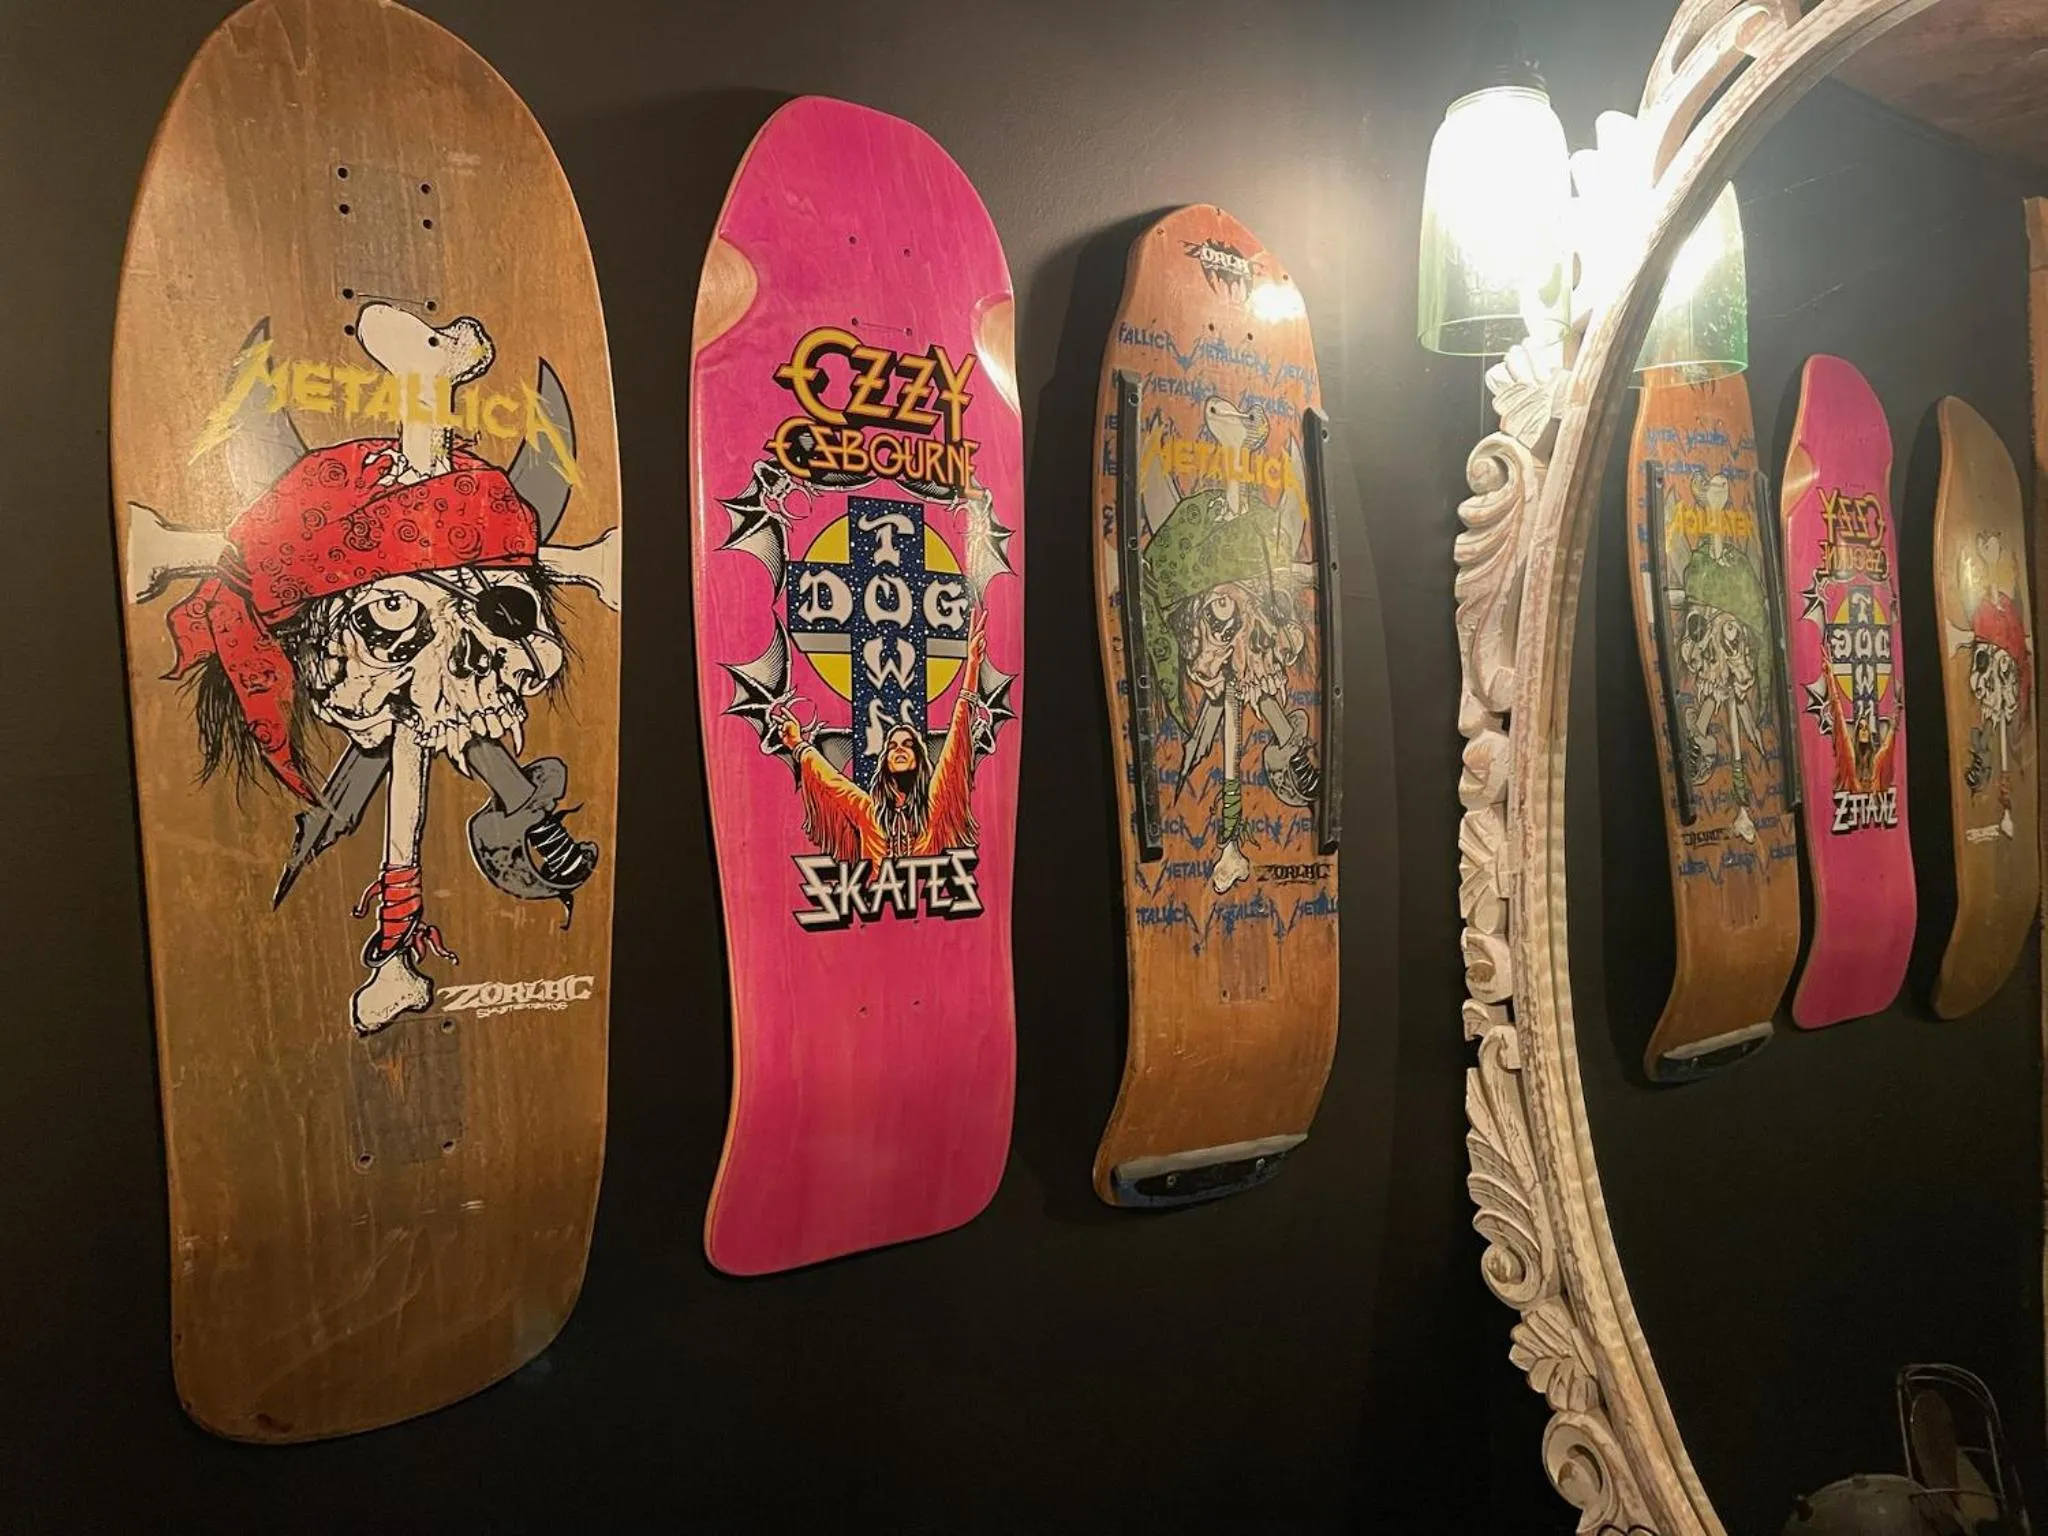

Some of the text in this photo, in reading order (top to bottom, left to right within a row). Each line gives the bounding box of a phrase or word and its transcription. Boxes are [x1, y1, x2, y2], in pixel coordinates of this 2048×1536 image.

[186, 338, 583, 488] METALLICA
[773, 326, 978, 446] OZZY
[763, 416, 986, 500] OSBOURNE
[1140, 424, 1310, 522] METALLICA
[798, 569, 970, 632] DOG
[791, 847, 985, 932] SKATES
